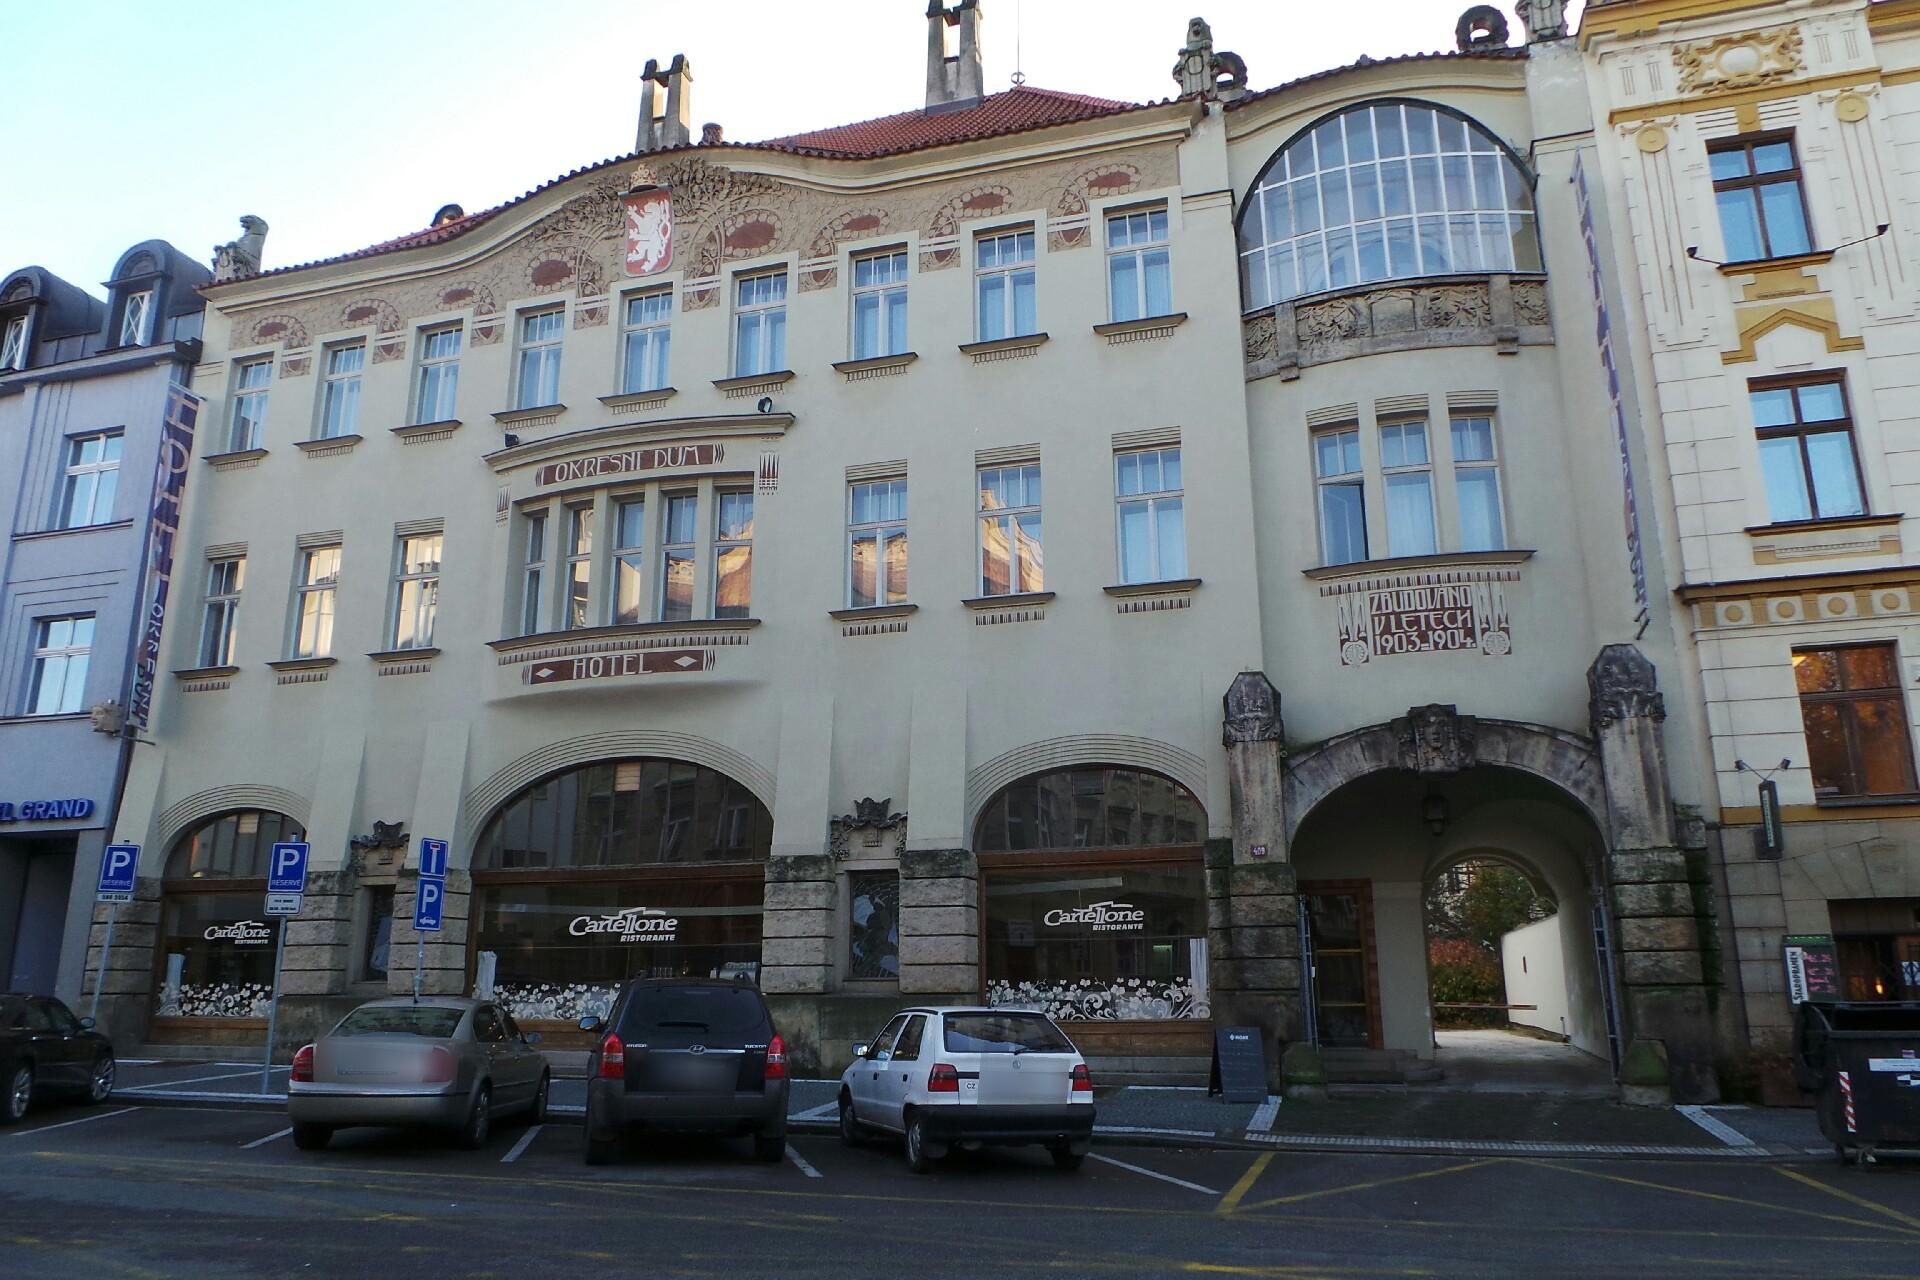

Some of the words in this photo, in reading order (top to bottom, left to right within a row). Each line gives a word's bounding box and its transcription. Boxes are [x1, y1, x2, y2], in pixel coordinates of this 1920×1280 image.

[148, 393, 199, 582] HOTEL
[1374, 616, 1386, 635] V
[1390, 609, 1472, 633] LETECH
[573, 653, 653, 680] HOTEL
[17, 799, 93, 820] GRAND
[108, 851, 131, 877] P
[277, 848, 301, 876] P
[421, 884, 439, 913] P
[568, 906, 678, 936] Cartellone
[1043, 901, 1144, 926] Cartellone
[620, 934, 676, 942] RISTORANTE
[1092, 923, 1144, 931] RISTORANTE
[966, 1082, 976, 1090] CZ
